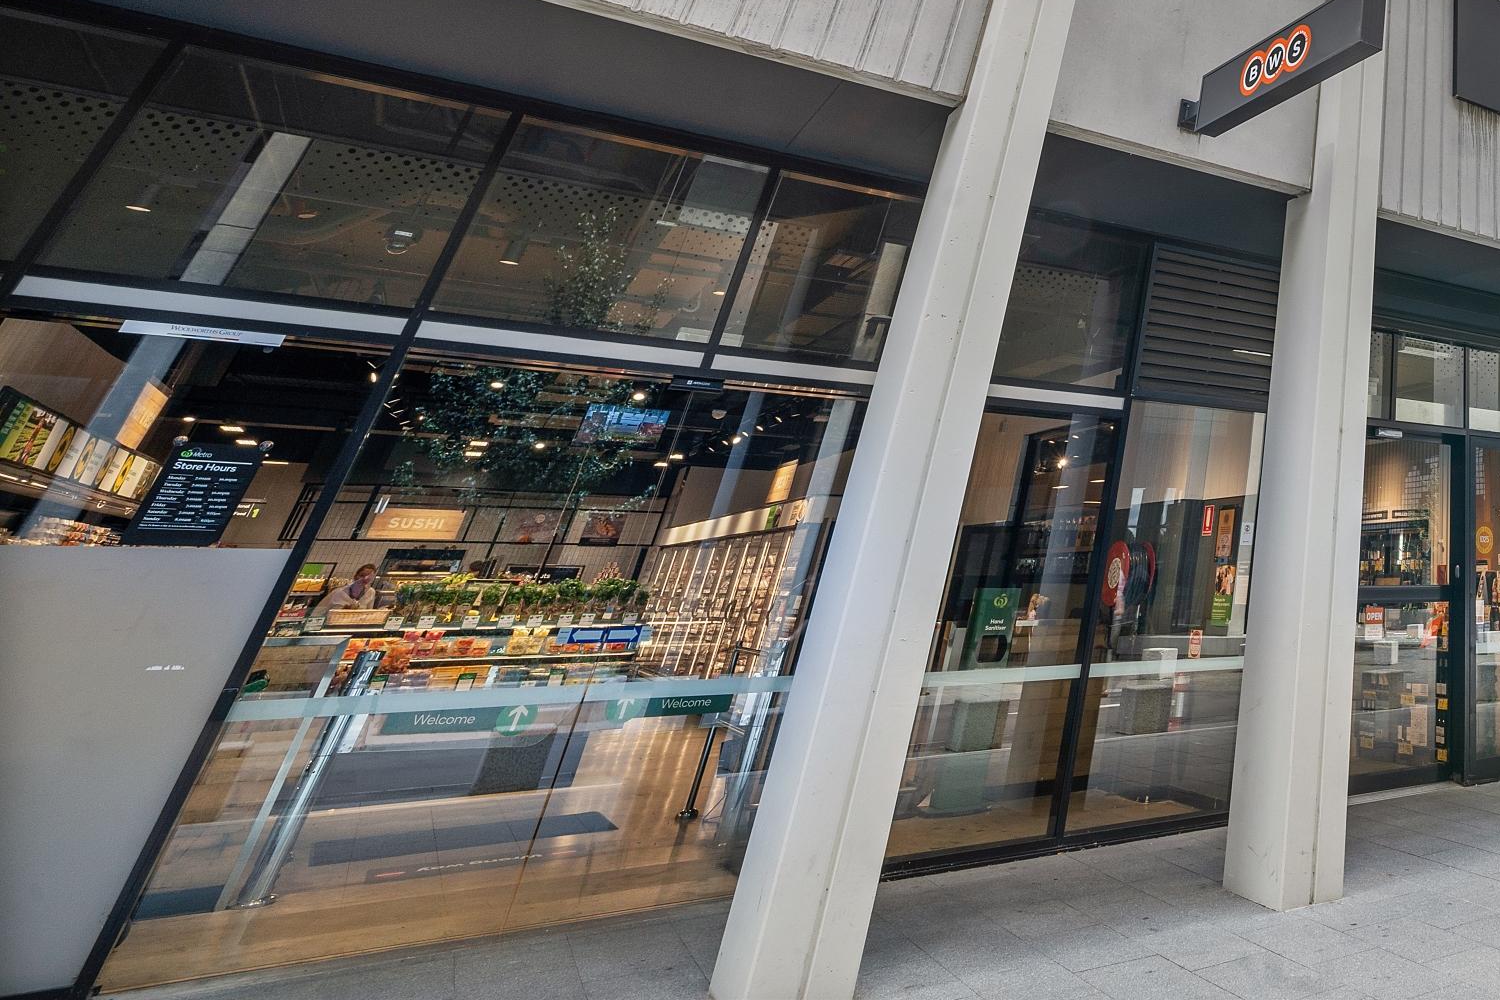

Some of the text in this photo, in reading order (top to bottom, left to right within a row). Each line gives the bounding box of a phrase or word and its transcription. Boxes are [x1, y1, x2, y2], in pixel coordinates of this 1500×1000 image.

[192, 451, 213, 459] Metro
[173, 461, 238, 473] Store Hours
[388, 517, 446, 530] SUSHI
[1366, 612, 1383, 621] OPEN
[660, 696, 713, 710] Welcome
[412, 713, 476, 727] Welcome
